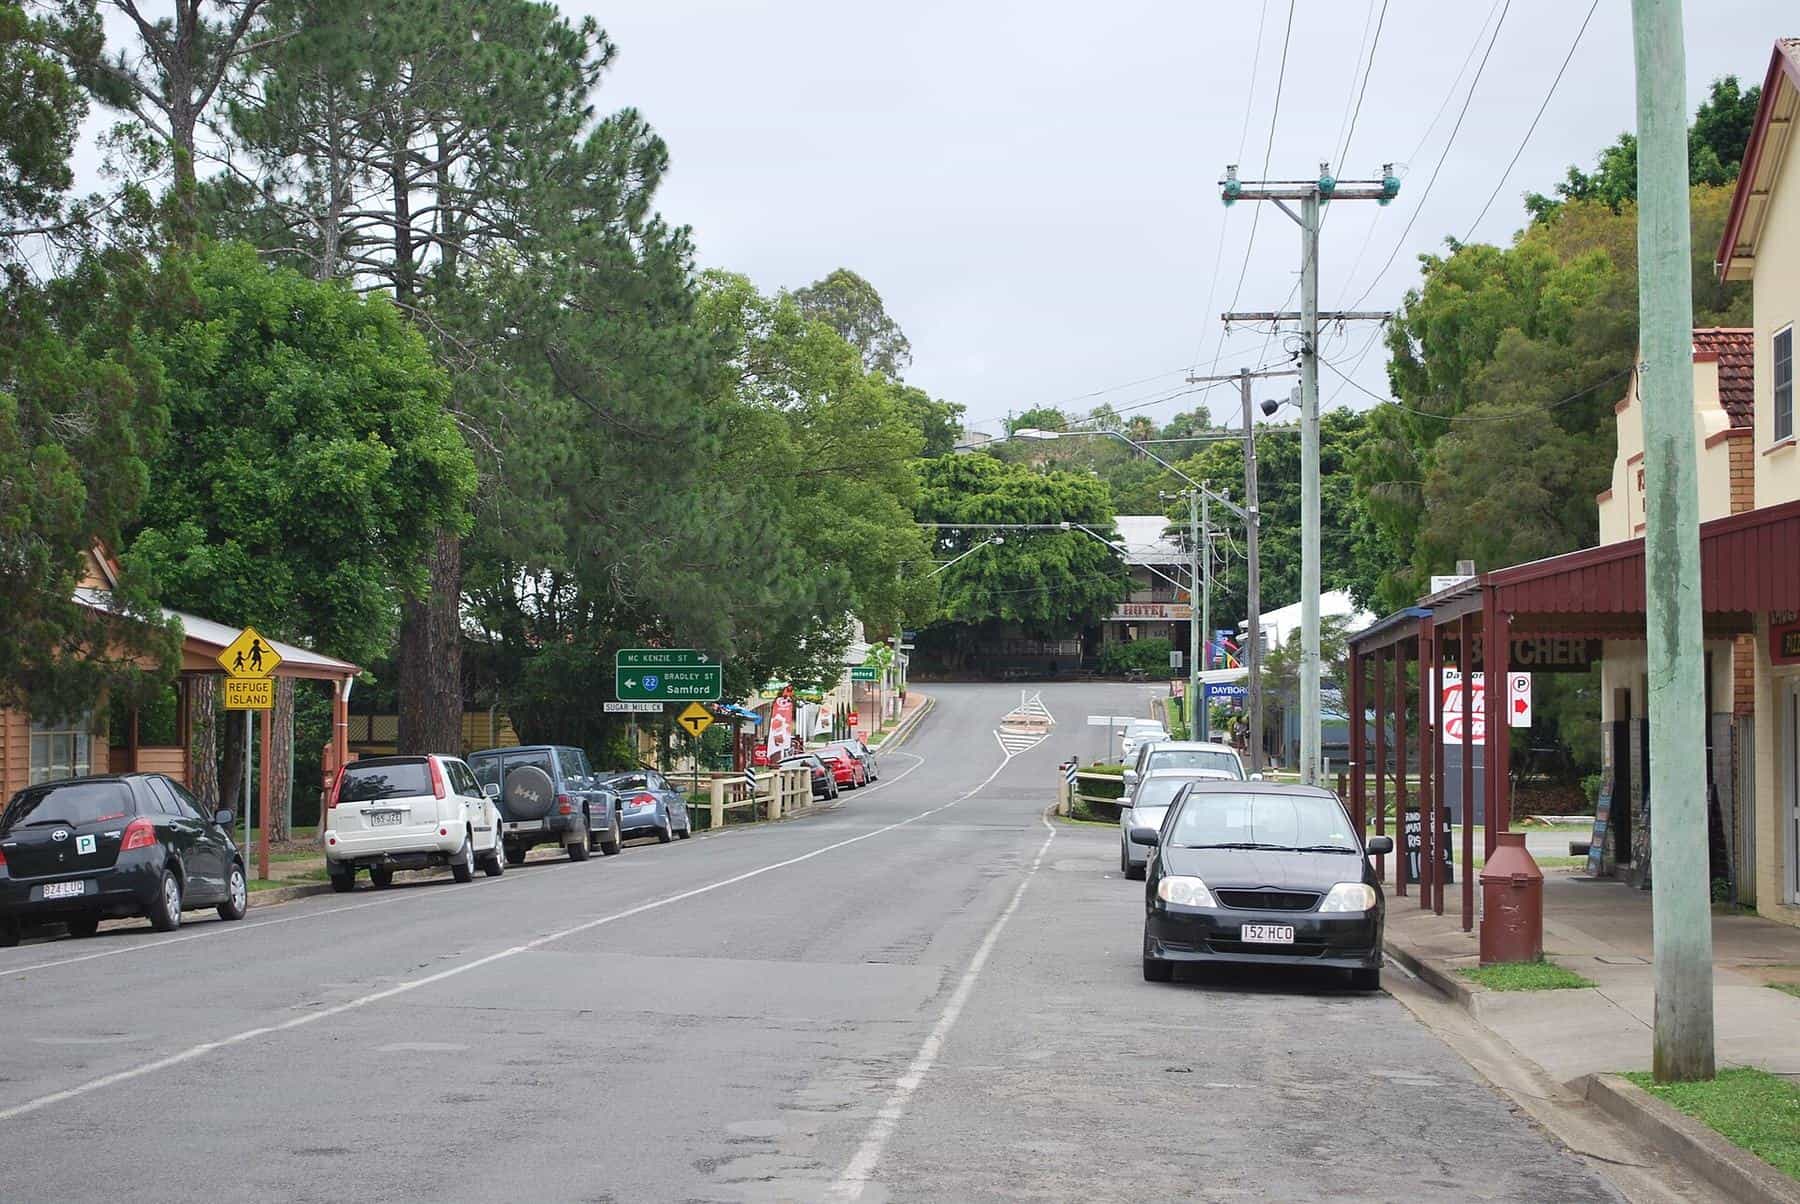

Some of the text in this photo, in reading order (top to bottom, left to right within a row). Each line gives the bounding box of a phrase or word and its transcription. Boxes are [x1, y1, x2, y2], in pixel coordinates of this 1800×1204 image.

[1124, 605, 1168, 618] HOTEL
[1471, 638, 1586, 665] BCHER
[628, 654, 688, 662] MC KENZIE ST
[229, 683, 269, 692] REFUGE
[645, 678, 656, 687] 22
[1517, 679, 1526, 689] P
[666, 685, 710, 694] Samford
[230, 694, 268, 704] ISLAND
[81, 839, 91, 851] P
[1244, 926, 1264, 939] 152
